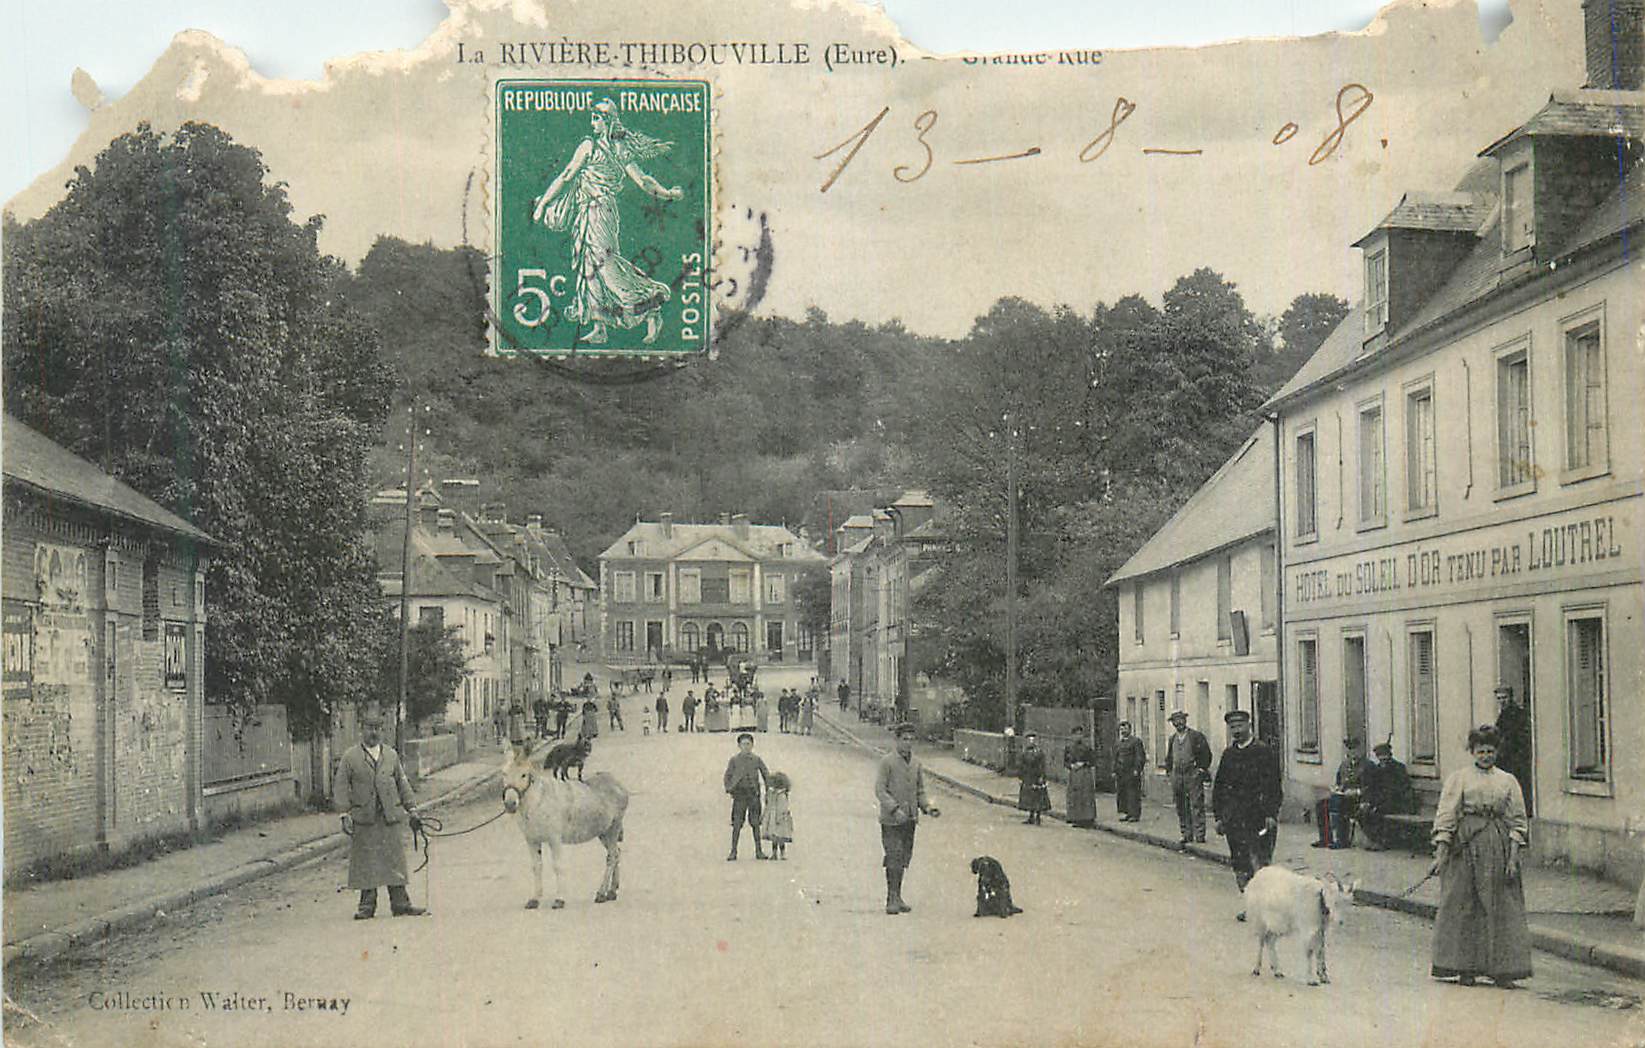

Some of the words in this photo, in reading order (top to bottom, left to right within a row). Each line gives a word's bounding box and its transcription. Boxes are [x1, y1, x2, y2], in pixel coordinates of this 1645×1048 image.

[620, 91, 702, 115] FRANÇAISE
[681, 252, 701, 341] POSTES
[1296, 569, 1332, 603] HOTEL
[1337, 573, 1352, 598] DU
[1356, 556, 1401, 595] SOLEIL
[1408, 546, 1441, 588] D'OR
[1447, 549, 1487, 583] TENU
[1491, 544, 1521, 577] PAR
[1528, 515, 1622, 572] LOUTREL
